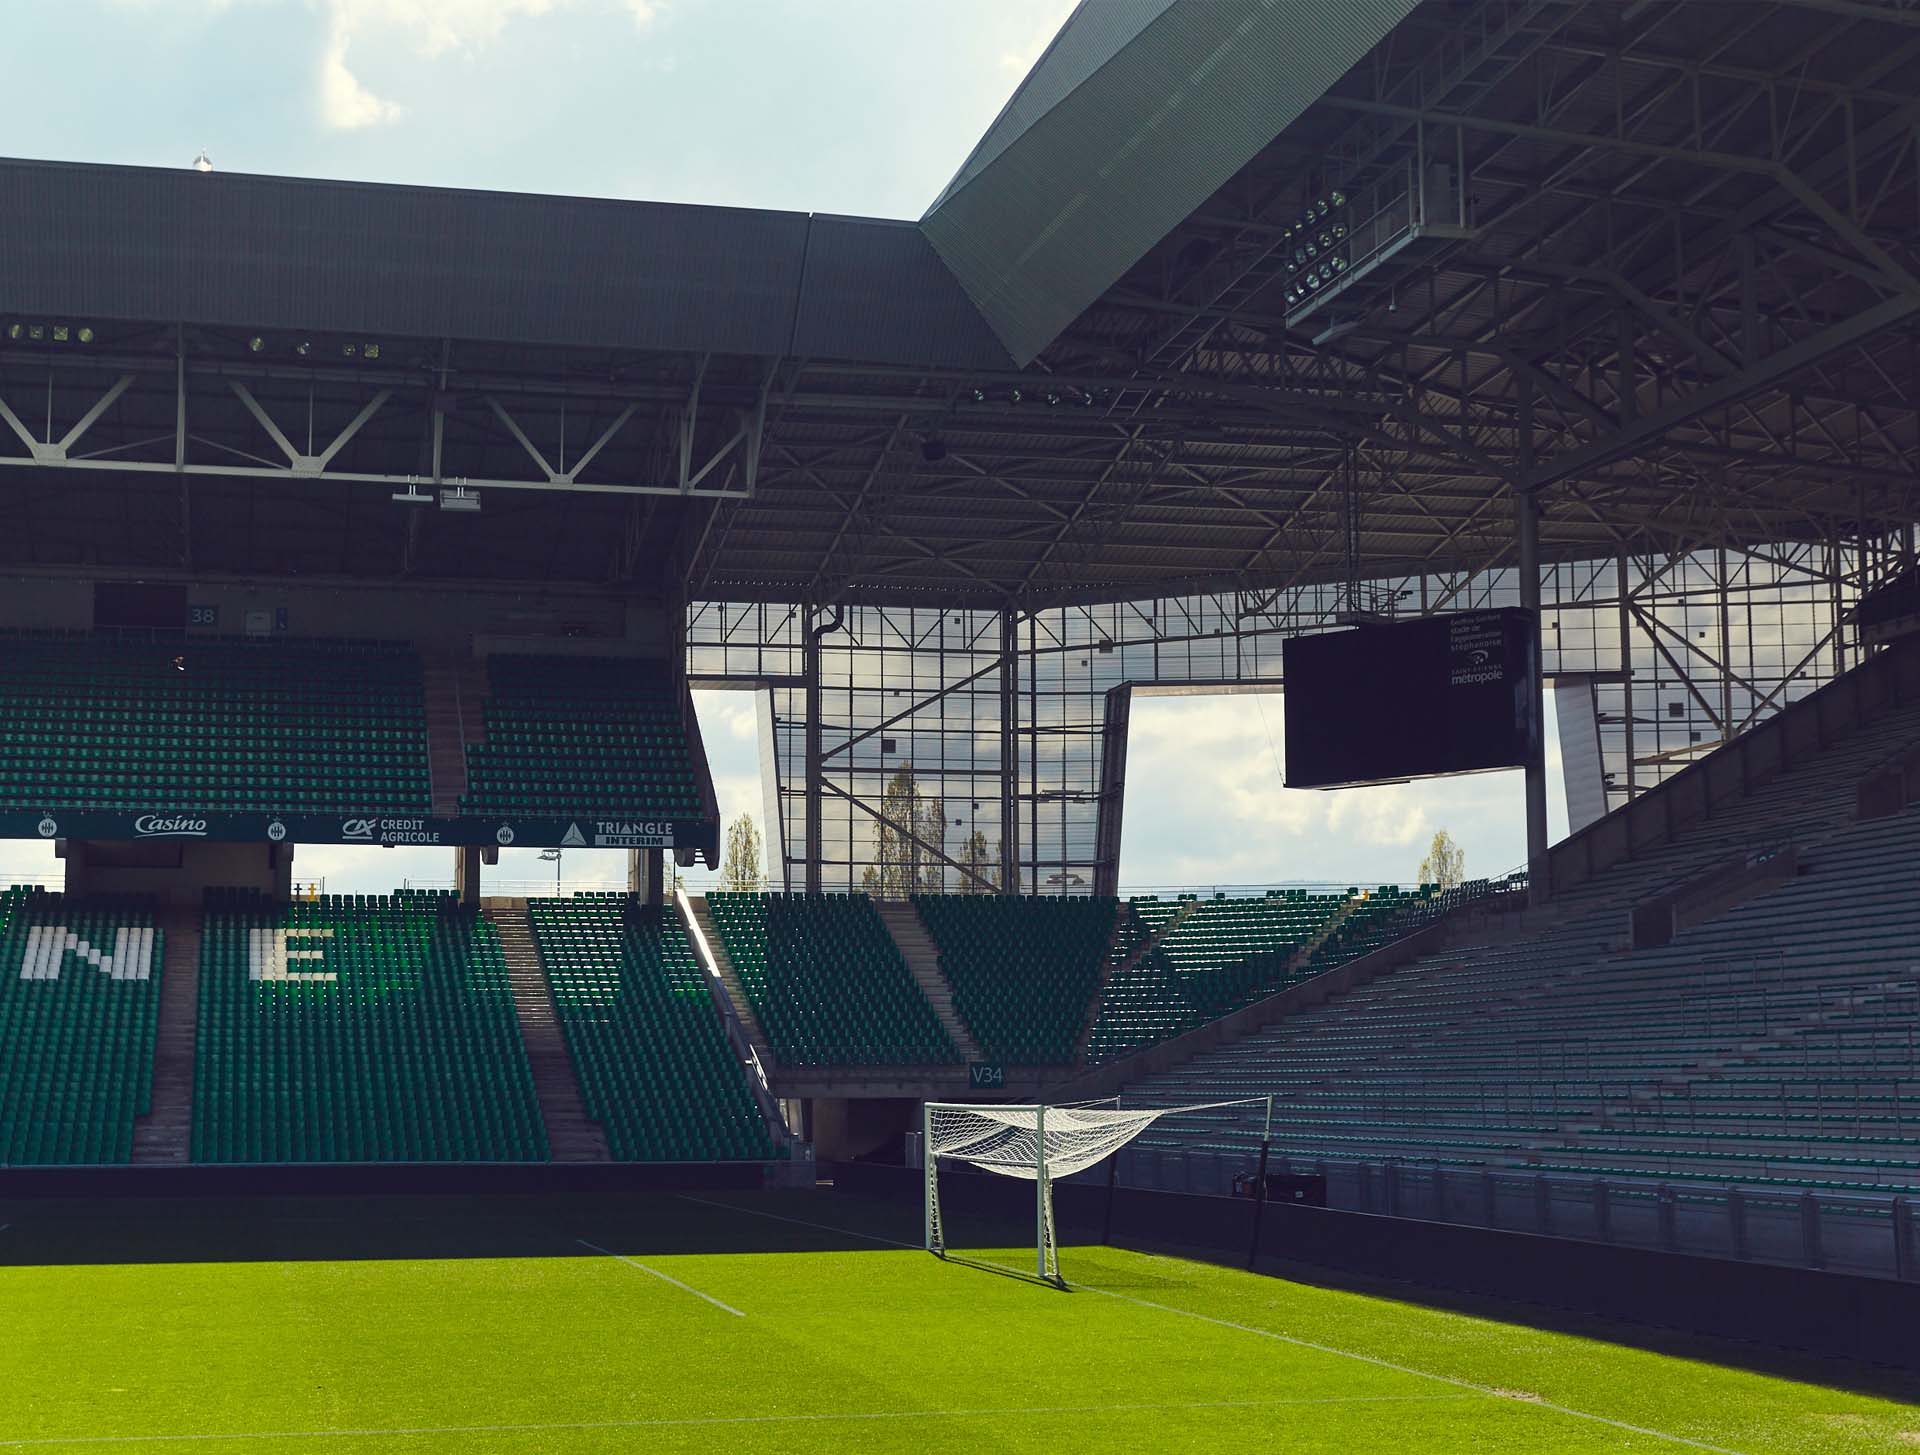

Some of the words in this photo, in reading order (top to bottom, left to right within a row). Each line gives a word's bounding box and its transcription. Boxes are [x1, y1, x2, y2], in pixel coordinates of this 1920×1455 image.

[191, 608, 215, 624] 38
[134, 814, 208, 834] Casino
[596, 821, 673, 835] TRIANGLE
[380, 831, 440, 843] AGRICOLE
[605, 836, 664, 845] INTERIM
[971, 1066, 1003, 1083] V34
